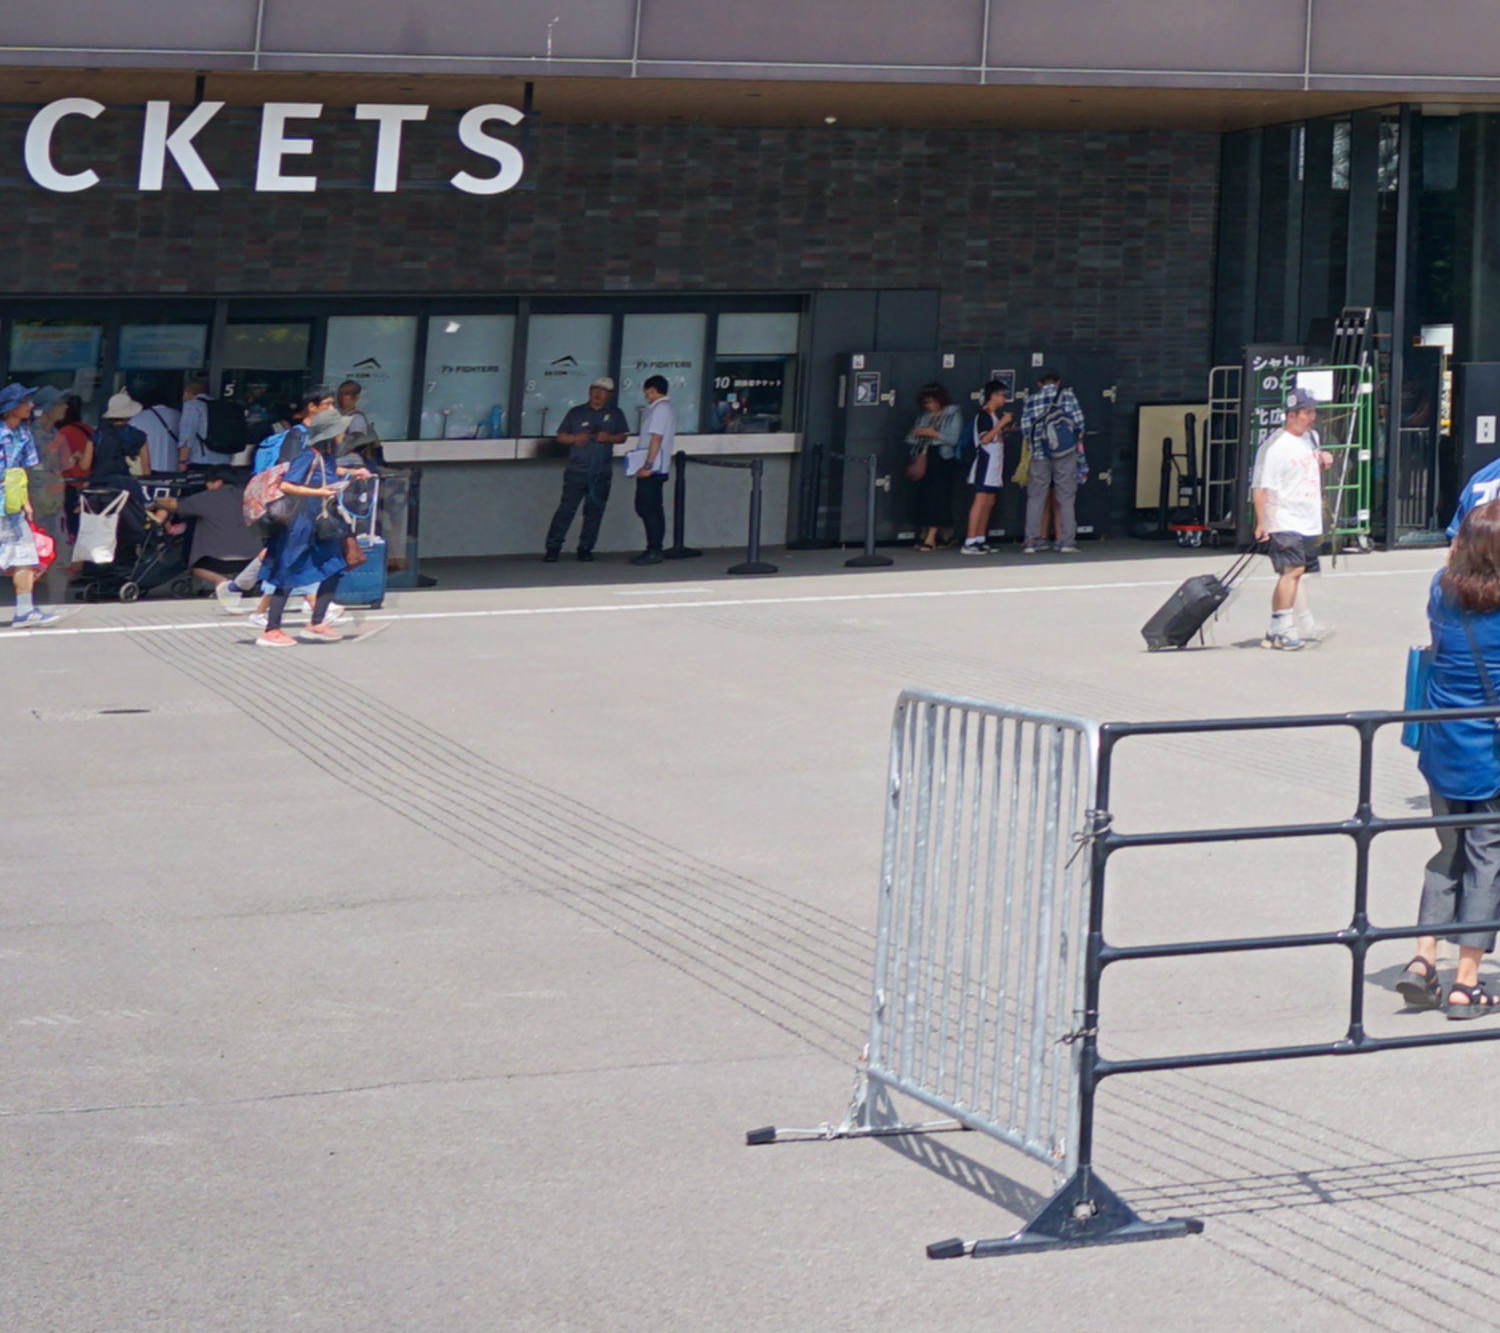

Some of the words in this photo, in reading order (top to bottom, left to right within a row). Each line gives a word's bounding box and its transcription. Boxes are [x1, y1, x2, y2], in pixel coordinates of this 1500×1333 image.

[23, 97, 526, 195] CKETS
[427, 381, 437, 393] 7
[526, 380, 536, 391] 8
[622, 379, 632, 391] 9
[714, 376, 730, 389] 10
[223, 384, 235, 397] 5
